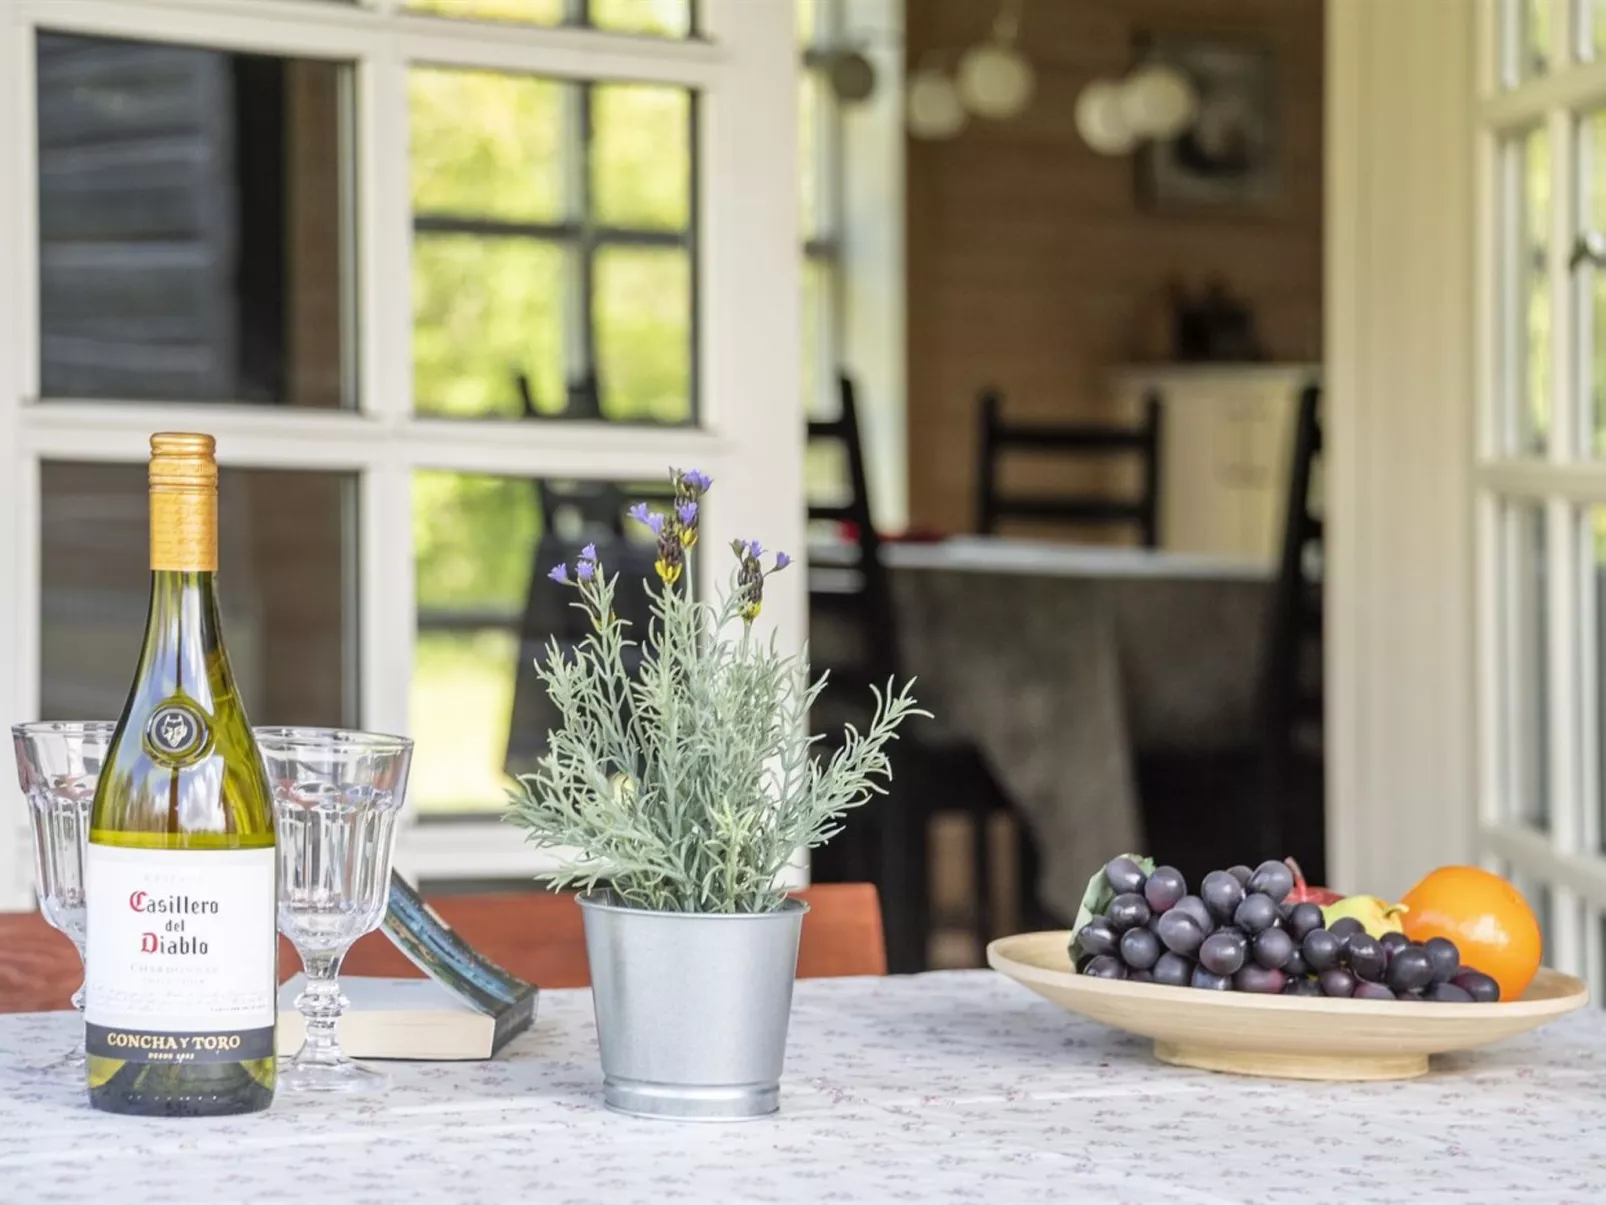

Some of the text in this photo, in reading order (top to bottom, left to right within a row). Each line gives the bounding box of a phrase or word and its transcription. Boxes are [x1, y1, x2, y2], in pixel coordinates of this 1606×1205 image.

[130, 891, 219, 914] Casillero
[165, 919, 185, 932] del
[141, 932, 209, 955] Diablo
[107, 1032, 240, 1050] CONCHA Y TORO
